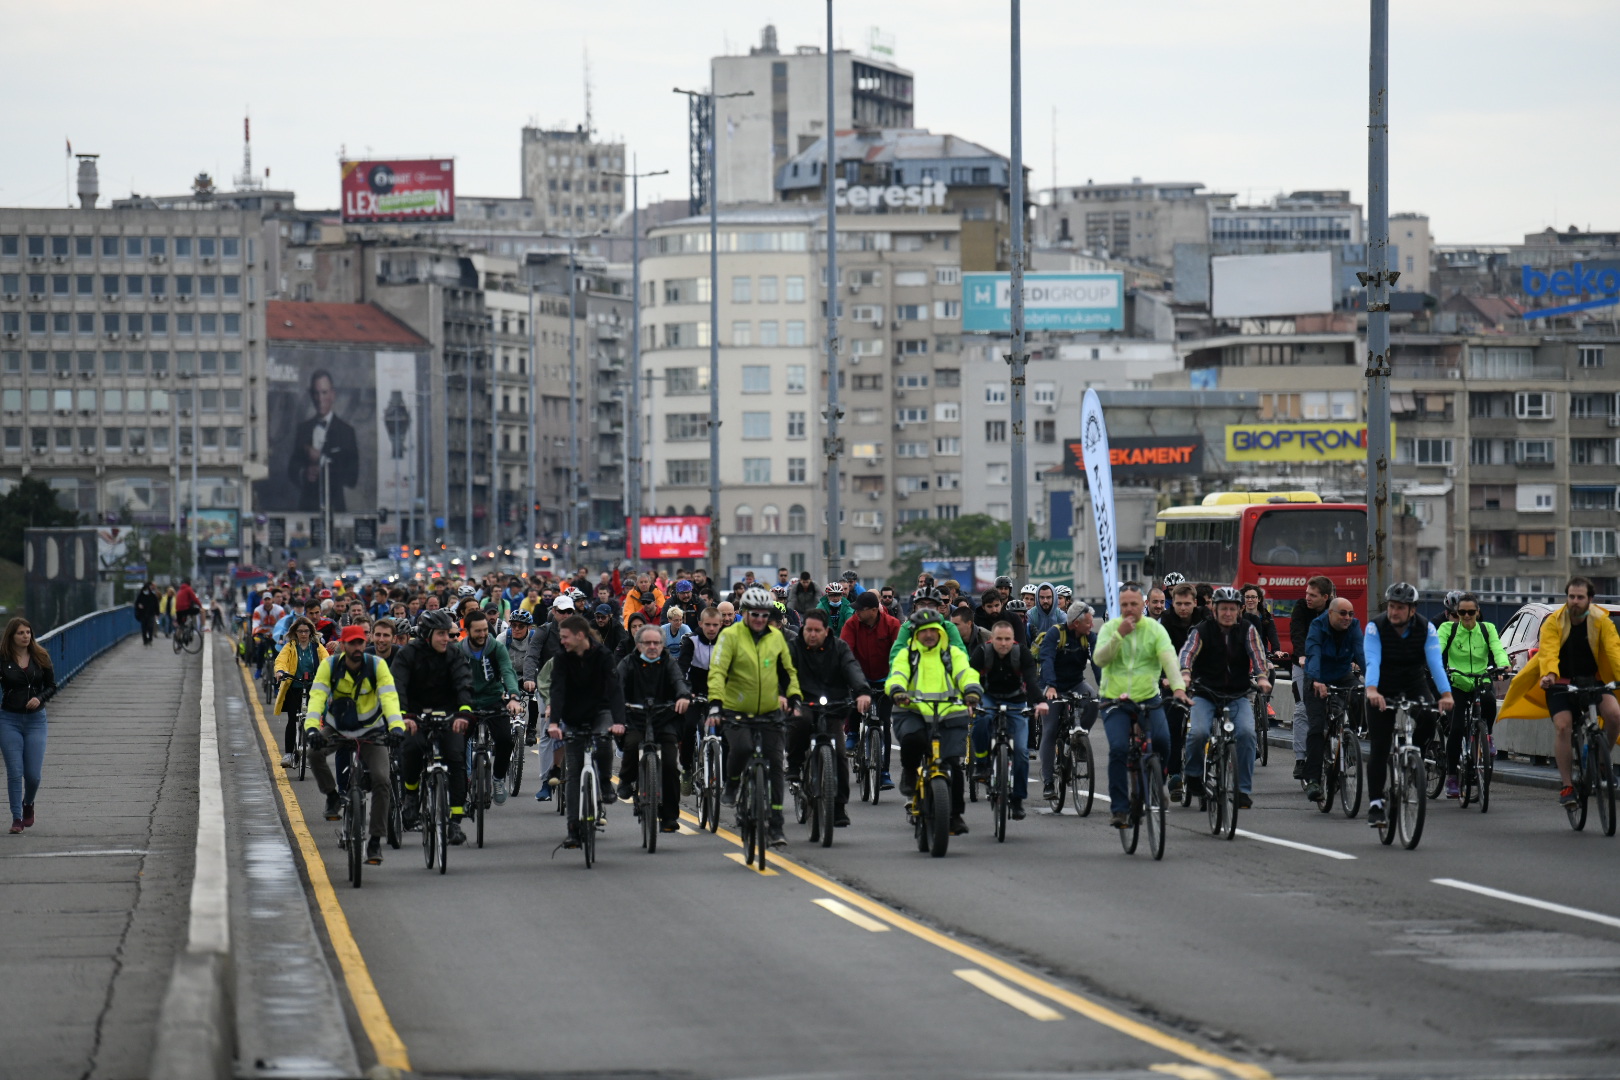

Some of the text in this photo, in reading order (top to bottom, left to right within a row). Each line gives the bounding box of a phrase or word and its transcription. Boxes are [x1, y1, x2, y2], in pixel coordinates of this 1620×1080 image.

[835, 176, 947, 207] Ceresit
[1522, 262, 1620, 297] beko
[1023, 312, 1062, 324] obrim
[1063, 312, 1111, 324] rukama
[1233, 429, 1361, 455] BIOPTRON
[1109, 444, 1197, 466] EKAMENT
[1268, 577, 1307, 586] DUMECO
